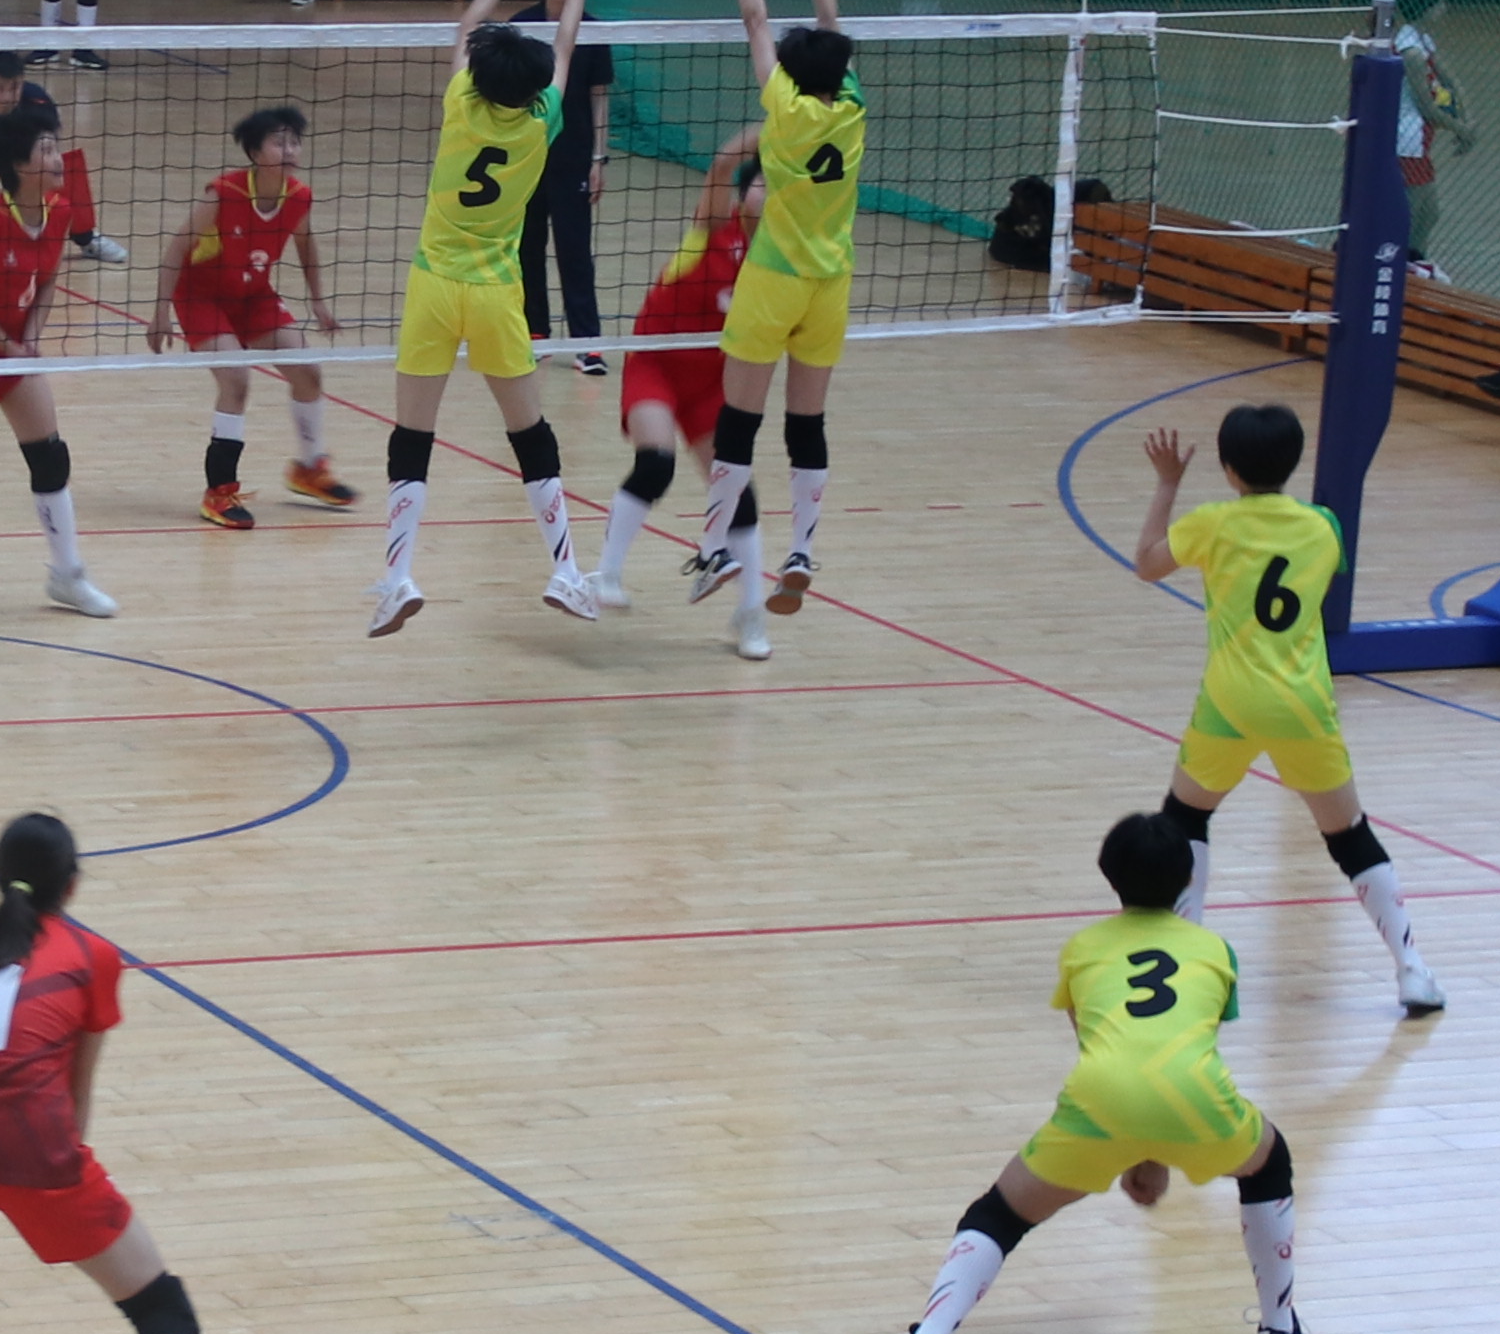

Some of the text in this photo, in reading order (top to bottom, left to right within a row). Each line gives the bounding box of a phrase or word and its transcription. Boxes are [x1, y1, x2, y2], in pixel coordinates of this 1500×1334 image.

[458, 146, 508, 207] 5
[1253, 555, 1301, 632] 6
[1125, 949, 1179, 1019] 3
